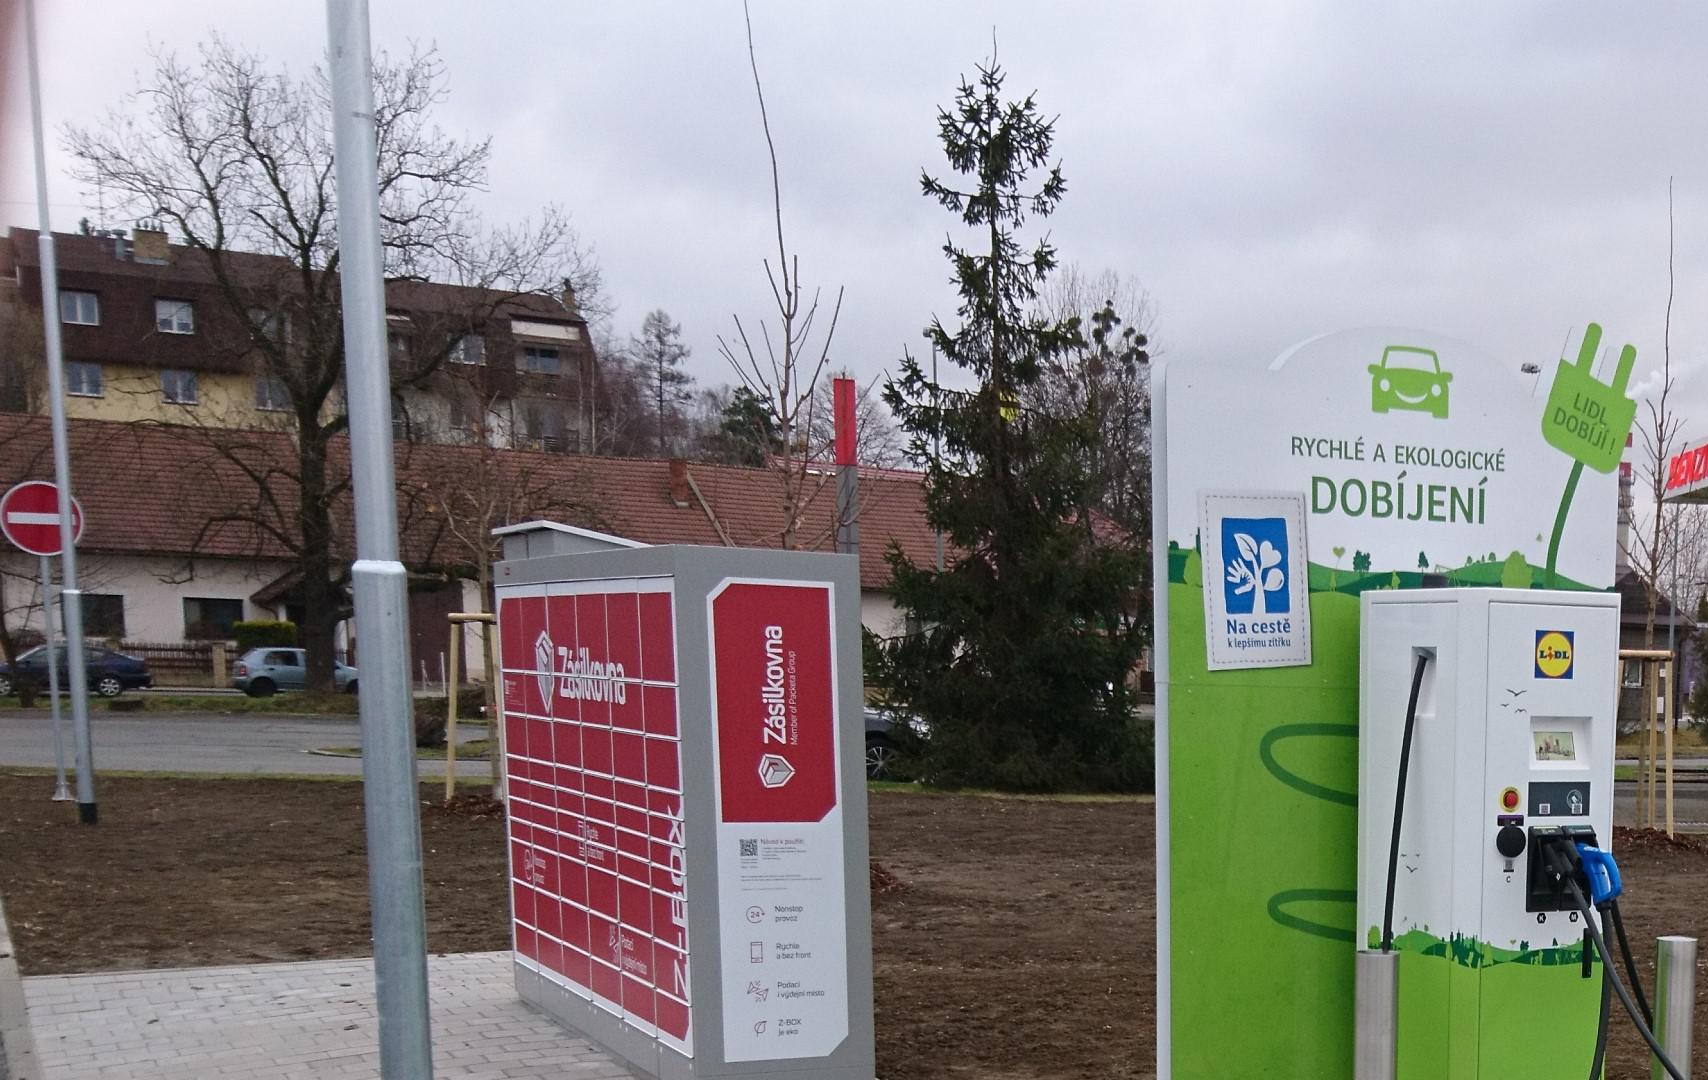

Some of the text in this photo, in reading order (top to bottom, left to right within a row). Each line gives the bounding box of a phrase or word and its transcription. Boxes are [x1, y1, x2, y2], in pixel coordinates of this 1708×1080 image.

[1573, 392, 1607, 426] LIDL
[1291, 436, 1505, 472] RYCHLÉ A EKOLOGICKÉ
[1311, 470, 1489, 524] DOBÍJENÍ
[1226, 618, 1291, 634] Na cestě
[1227, 636, 1291, 651] k lepšímu zítřku
[558, 646, 626, 705] Zásilkovna
[762, 625, 787, 745] Zásilkovna
[787, 651, 798, 746] Member of Packeta Group
[667, 804, 690, 1000] Z-BOX
[774, 905, 804, 913] Nonstop
